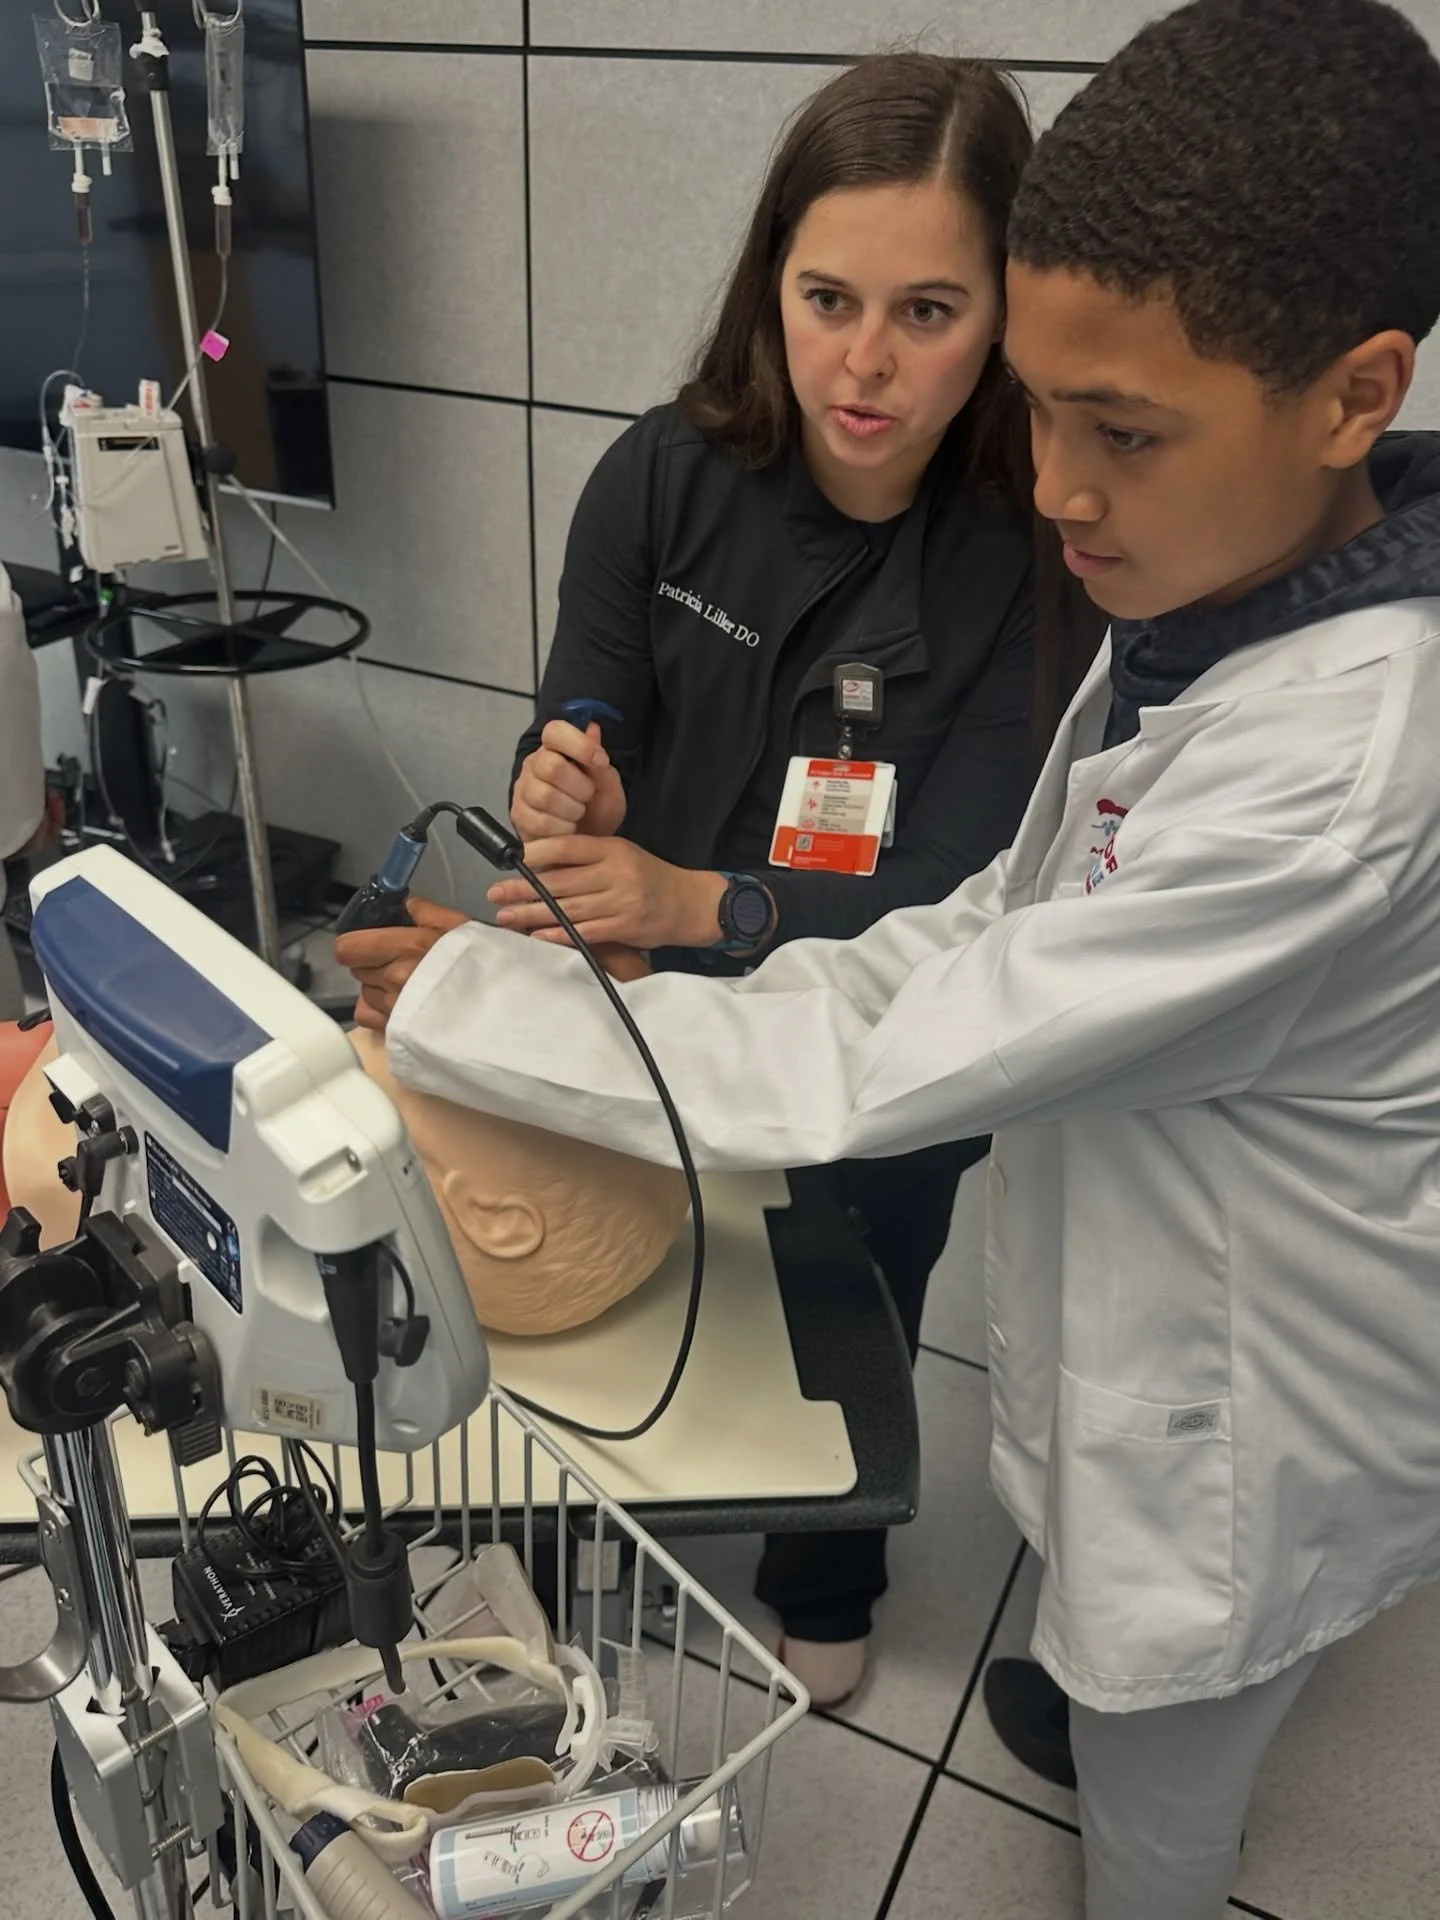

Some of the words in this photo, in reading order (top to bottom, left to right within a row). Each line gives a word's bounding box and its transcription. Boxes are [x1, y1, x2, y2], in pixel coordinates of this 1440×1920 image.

[658, 581, 703, 613] Patricia
[733, 625, 760, 647] DO
[203, 1565, 232, 1609] VERATHON
